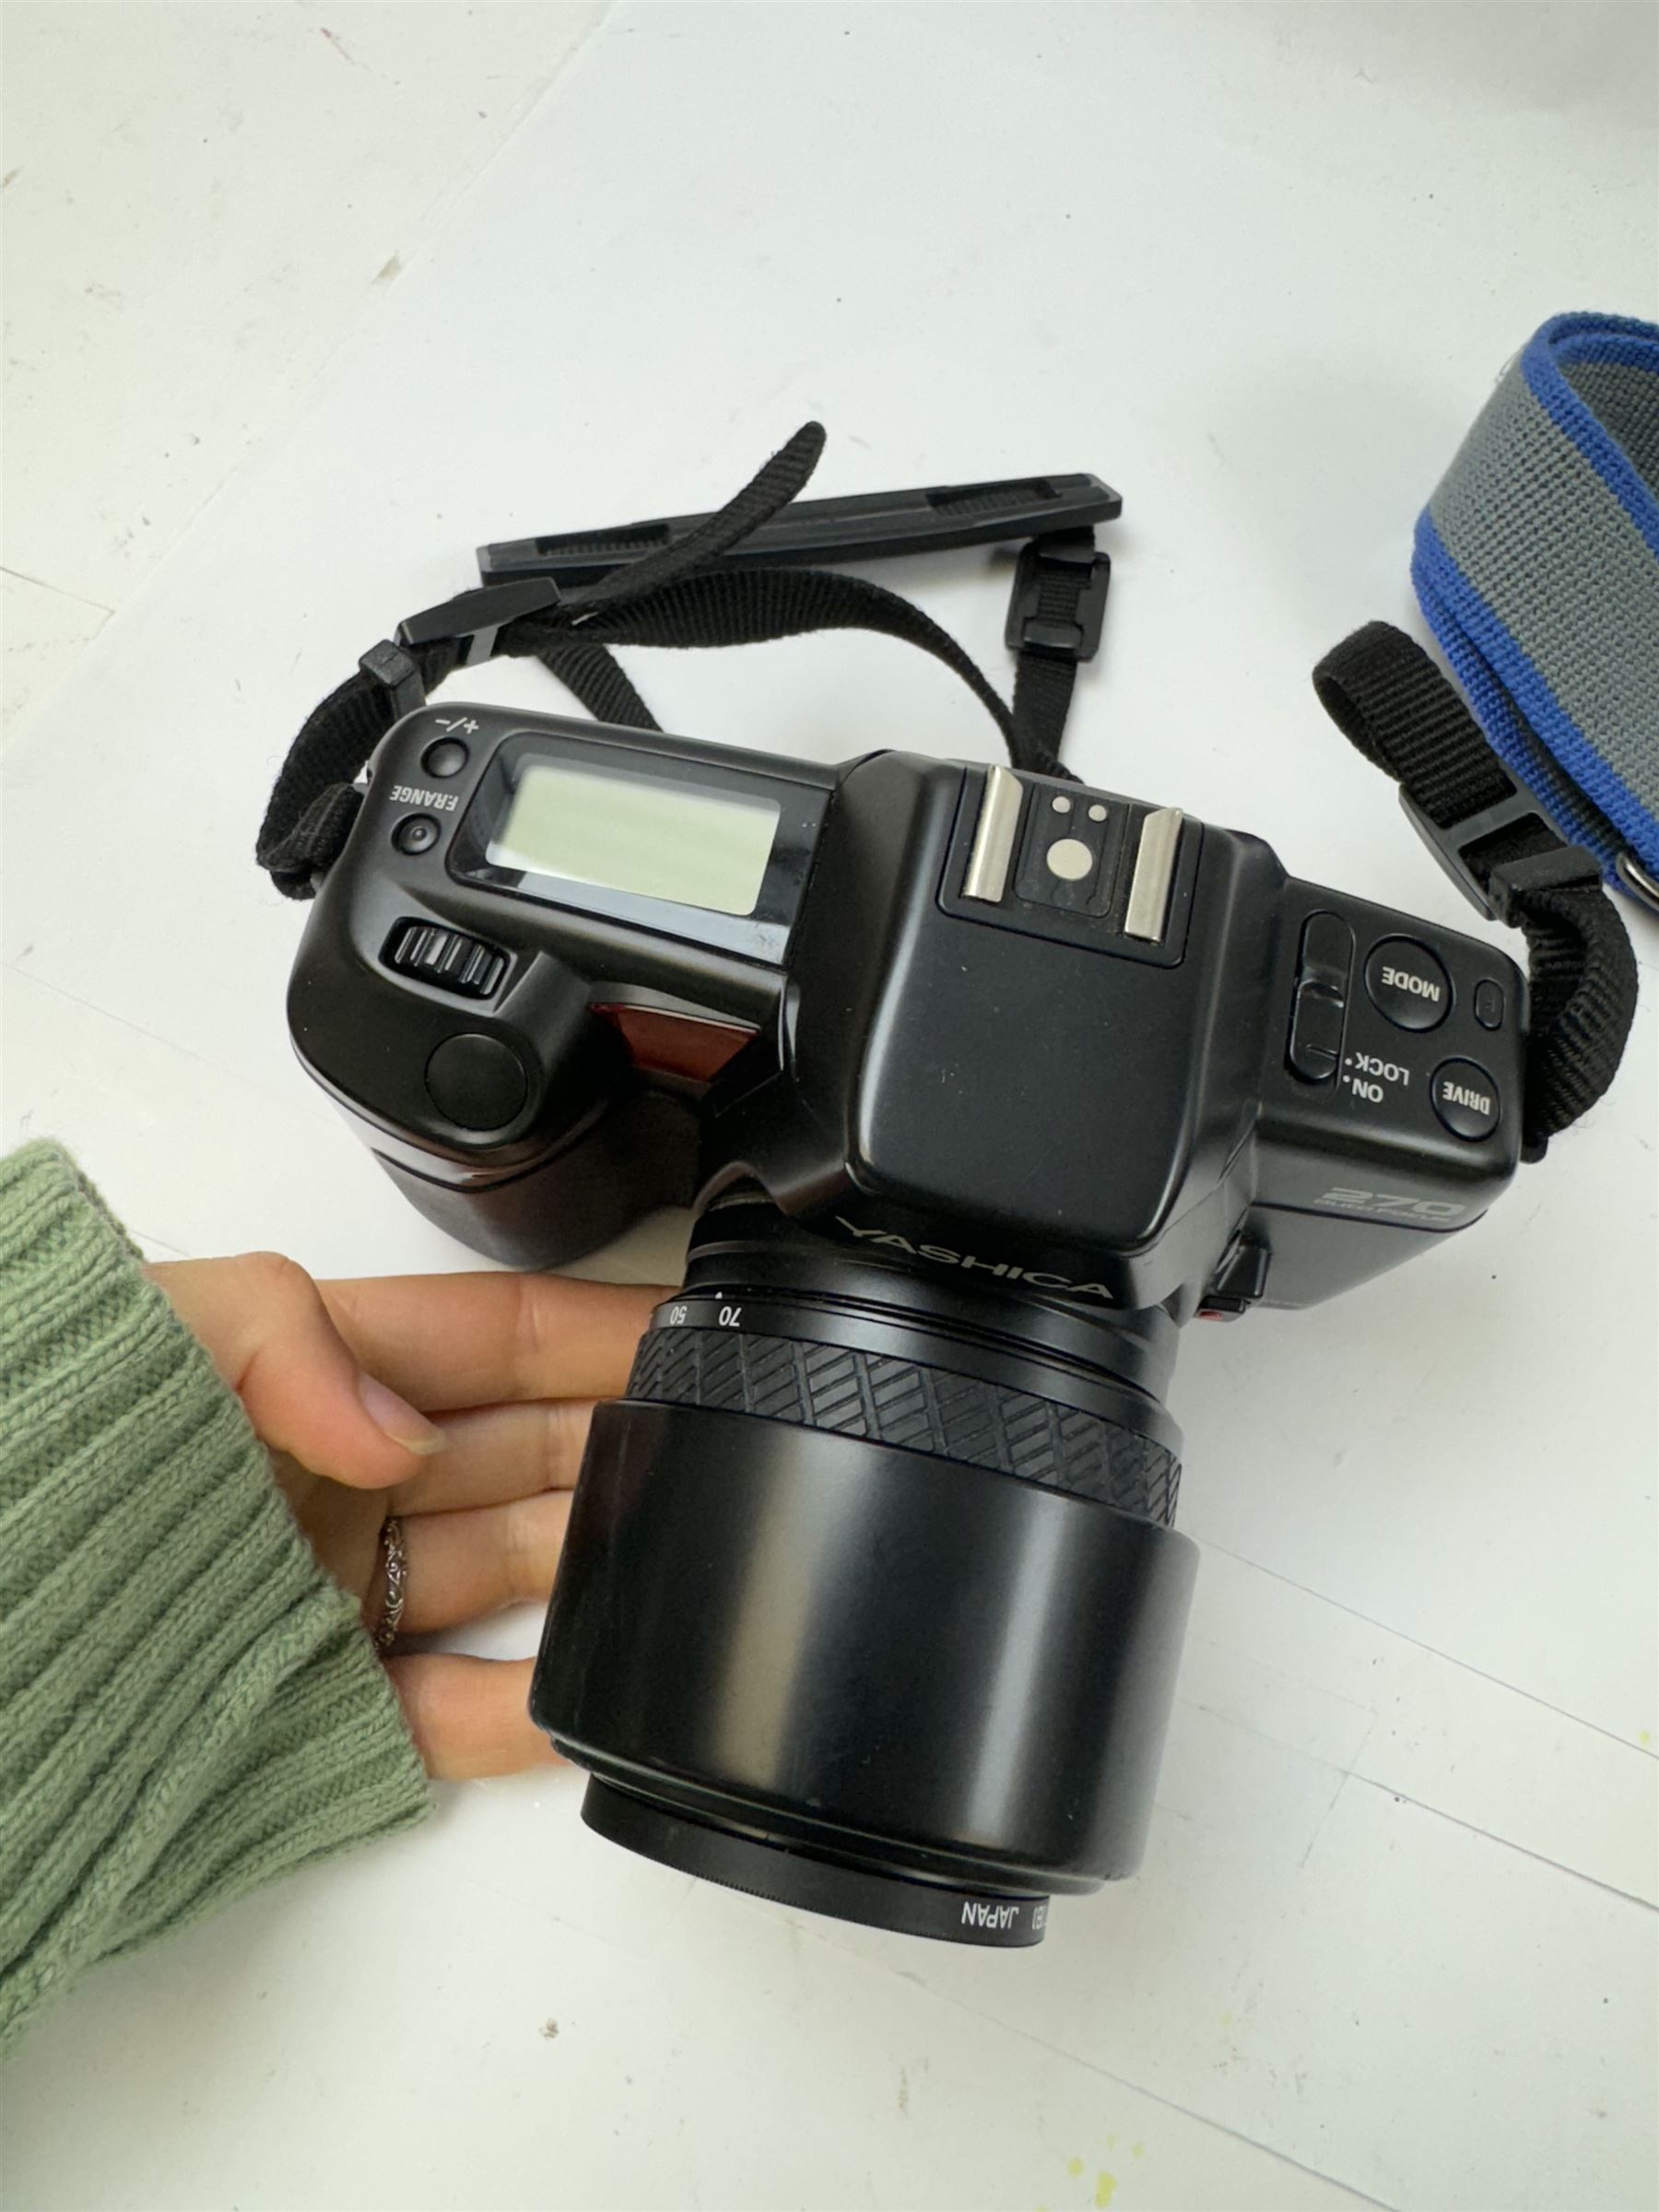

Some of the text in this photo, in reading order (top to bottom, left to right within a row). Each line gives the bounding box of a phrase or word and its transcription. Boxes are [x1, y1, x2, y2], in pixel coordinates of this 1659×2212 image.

[1382, 967, 1441, 1002] MODE
[1355, 1052, 1409, 1086] LOCK
[1351, 1078, 1383, 1102] ON
[1442, 1081, 1490, 1115] DRIVE
[1321, 1186, 1466, 1217] 270
[835, 1216, 1113, 1299] YASHICA
[670, 1305, 688, 1324] 50
[719, 1305, 742, 1327] 70
[961, 1900, 1019, 1929] JAPAN
